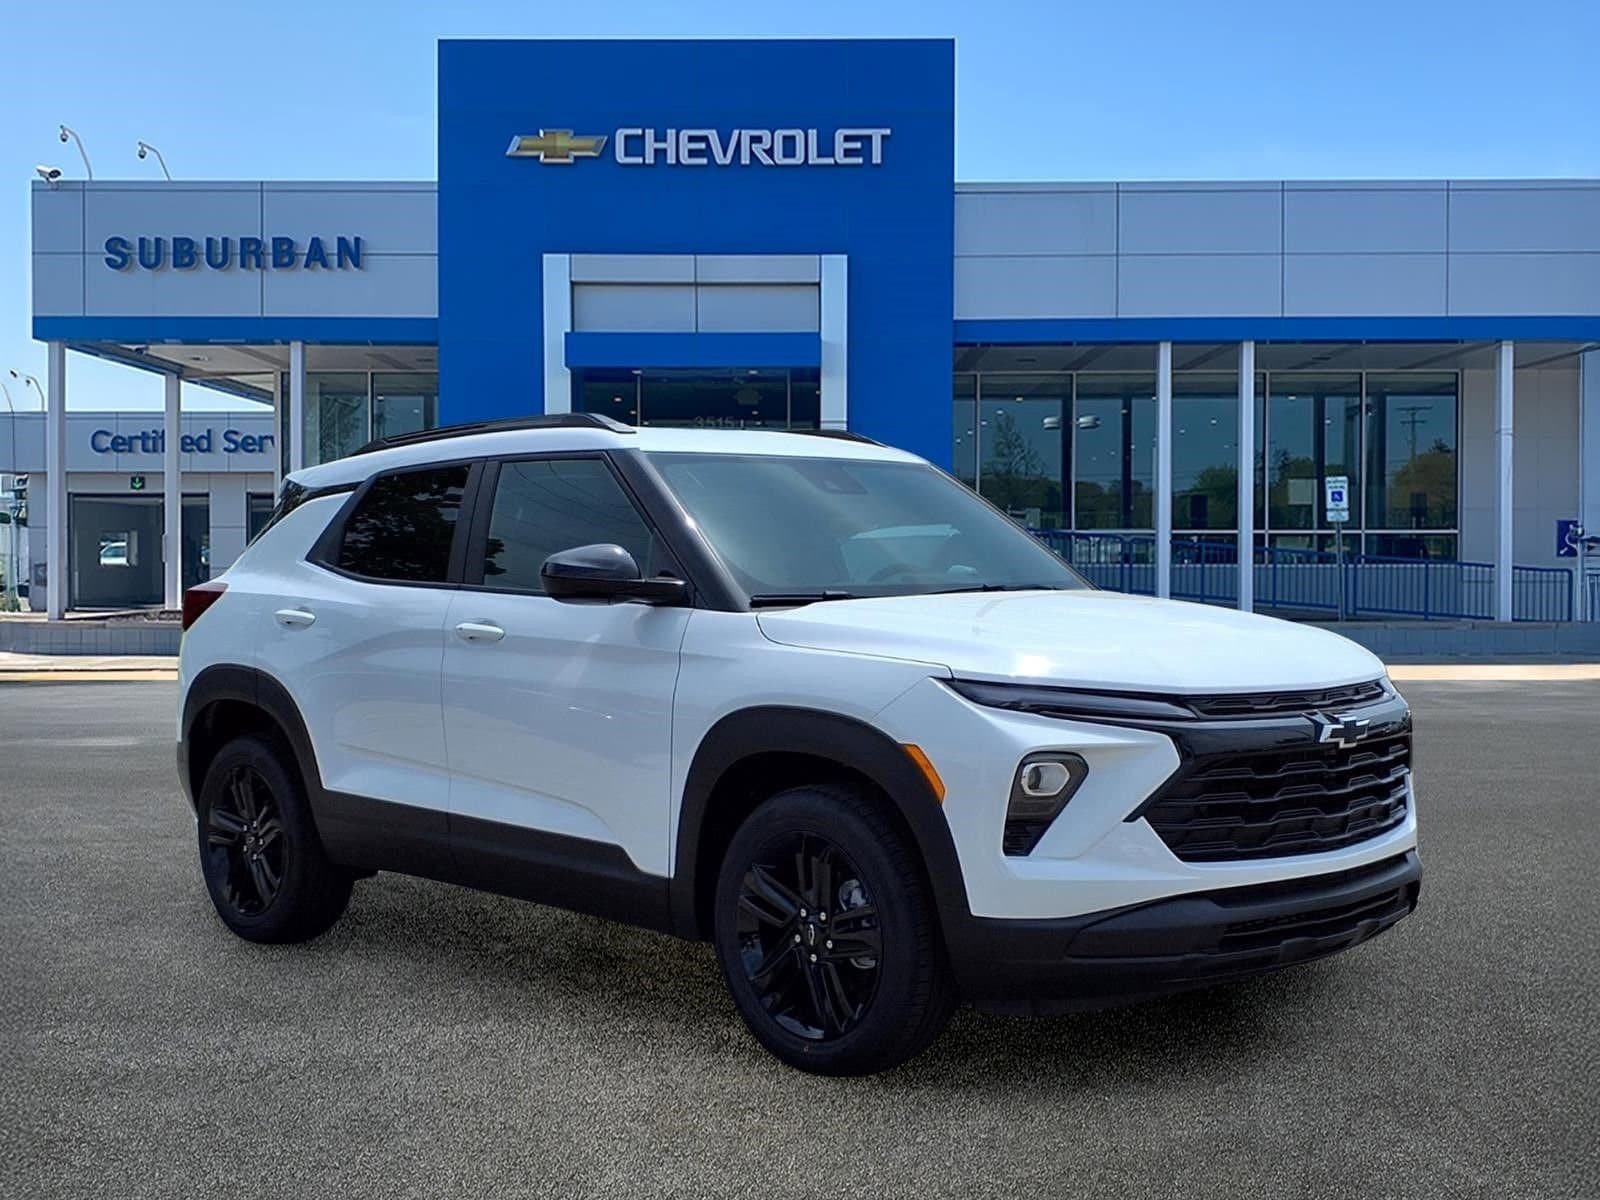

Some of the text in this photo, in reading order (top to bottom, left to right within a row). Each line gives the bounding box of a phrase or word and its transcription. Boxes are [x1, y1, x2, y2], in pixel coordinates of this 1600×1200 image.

[615, 128, 891, 164] CHEVROLET
[104, 236, 363, 271] SUBURBAN
[91, 429, 213, 453] Certifed
